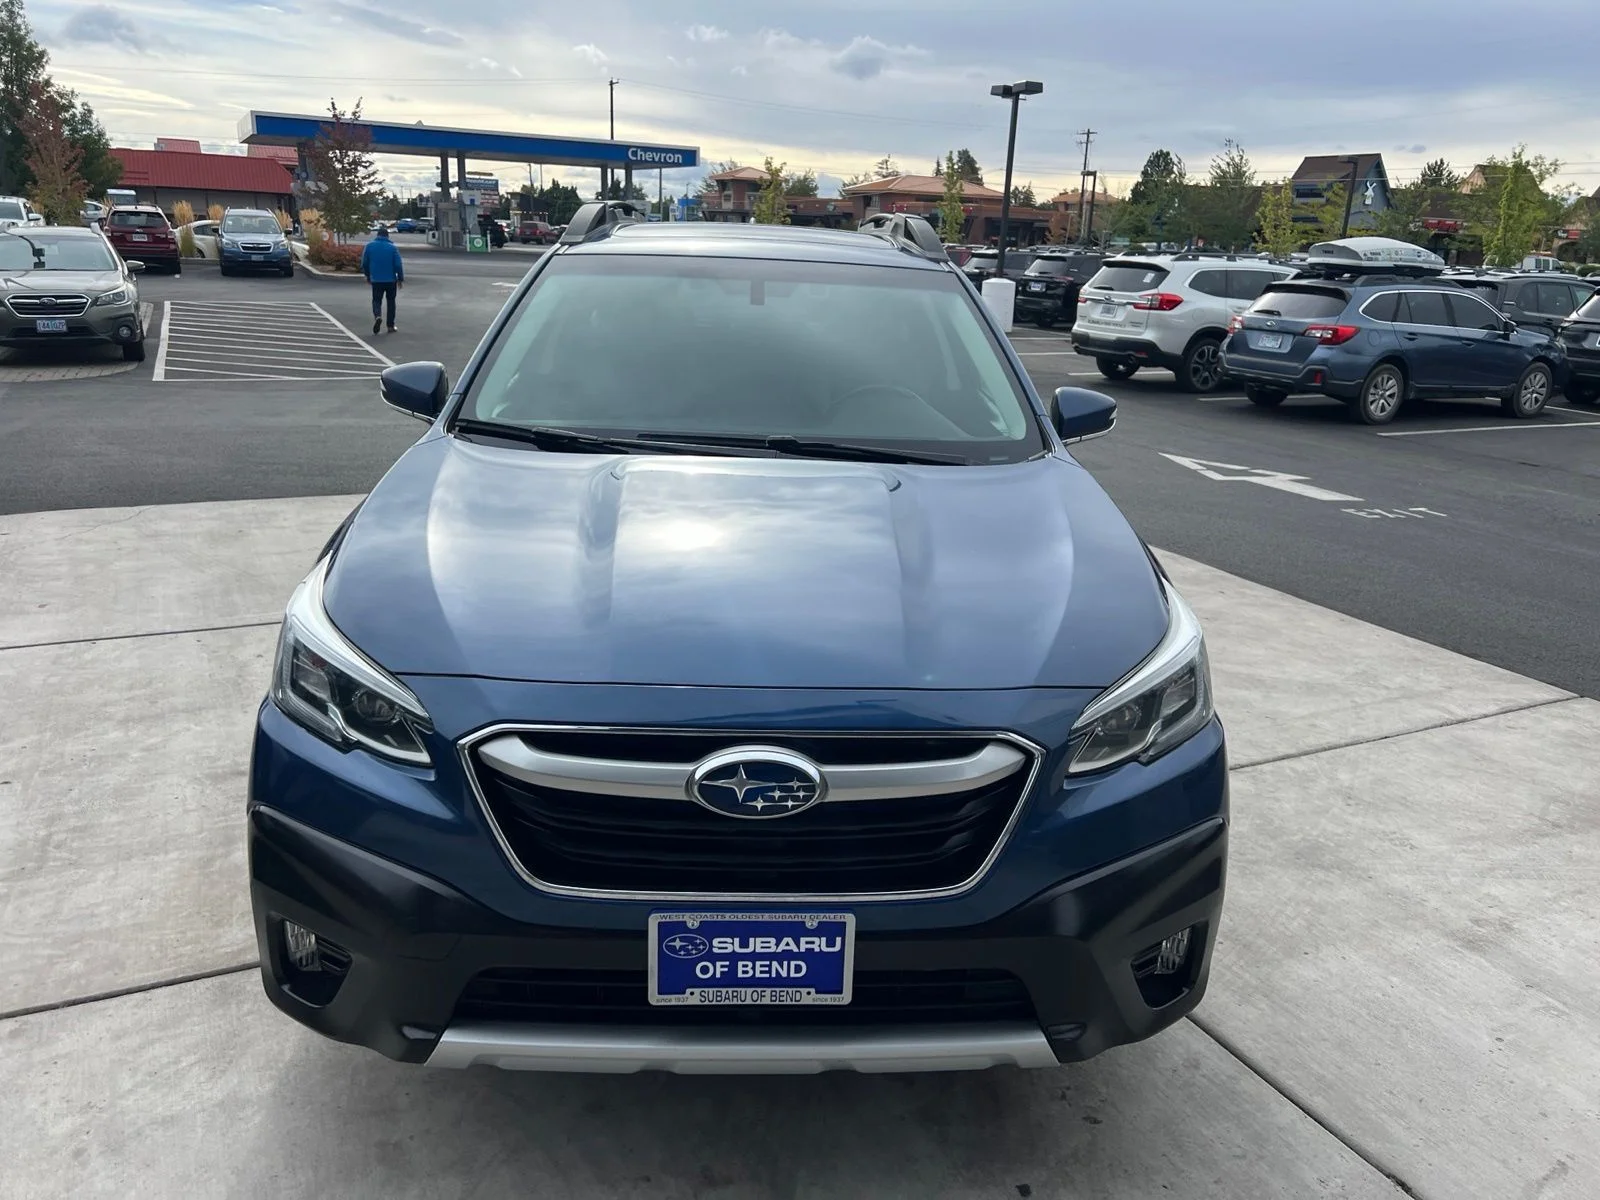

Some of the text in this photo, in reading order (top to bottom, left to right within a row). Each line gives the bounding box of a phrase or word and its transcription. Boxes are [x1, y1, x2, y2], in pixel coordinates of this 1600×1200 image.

[628, 148, 682, 163] Chevron
[712, 937, 842, 953] SUBARU
[695, 961, 807, 979] OF BEND
[699, 990, 802, 1003] SUBARU OF BEND
